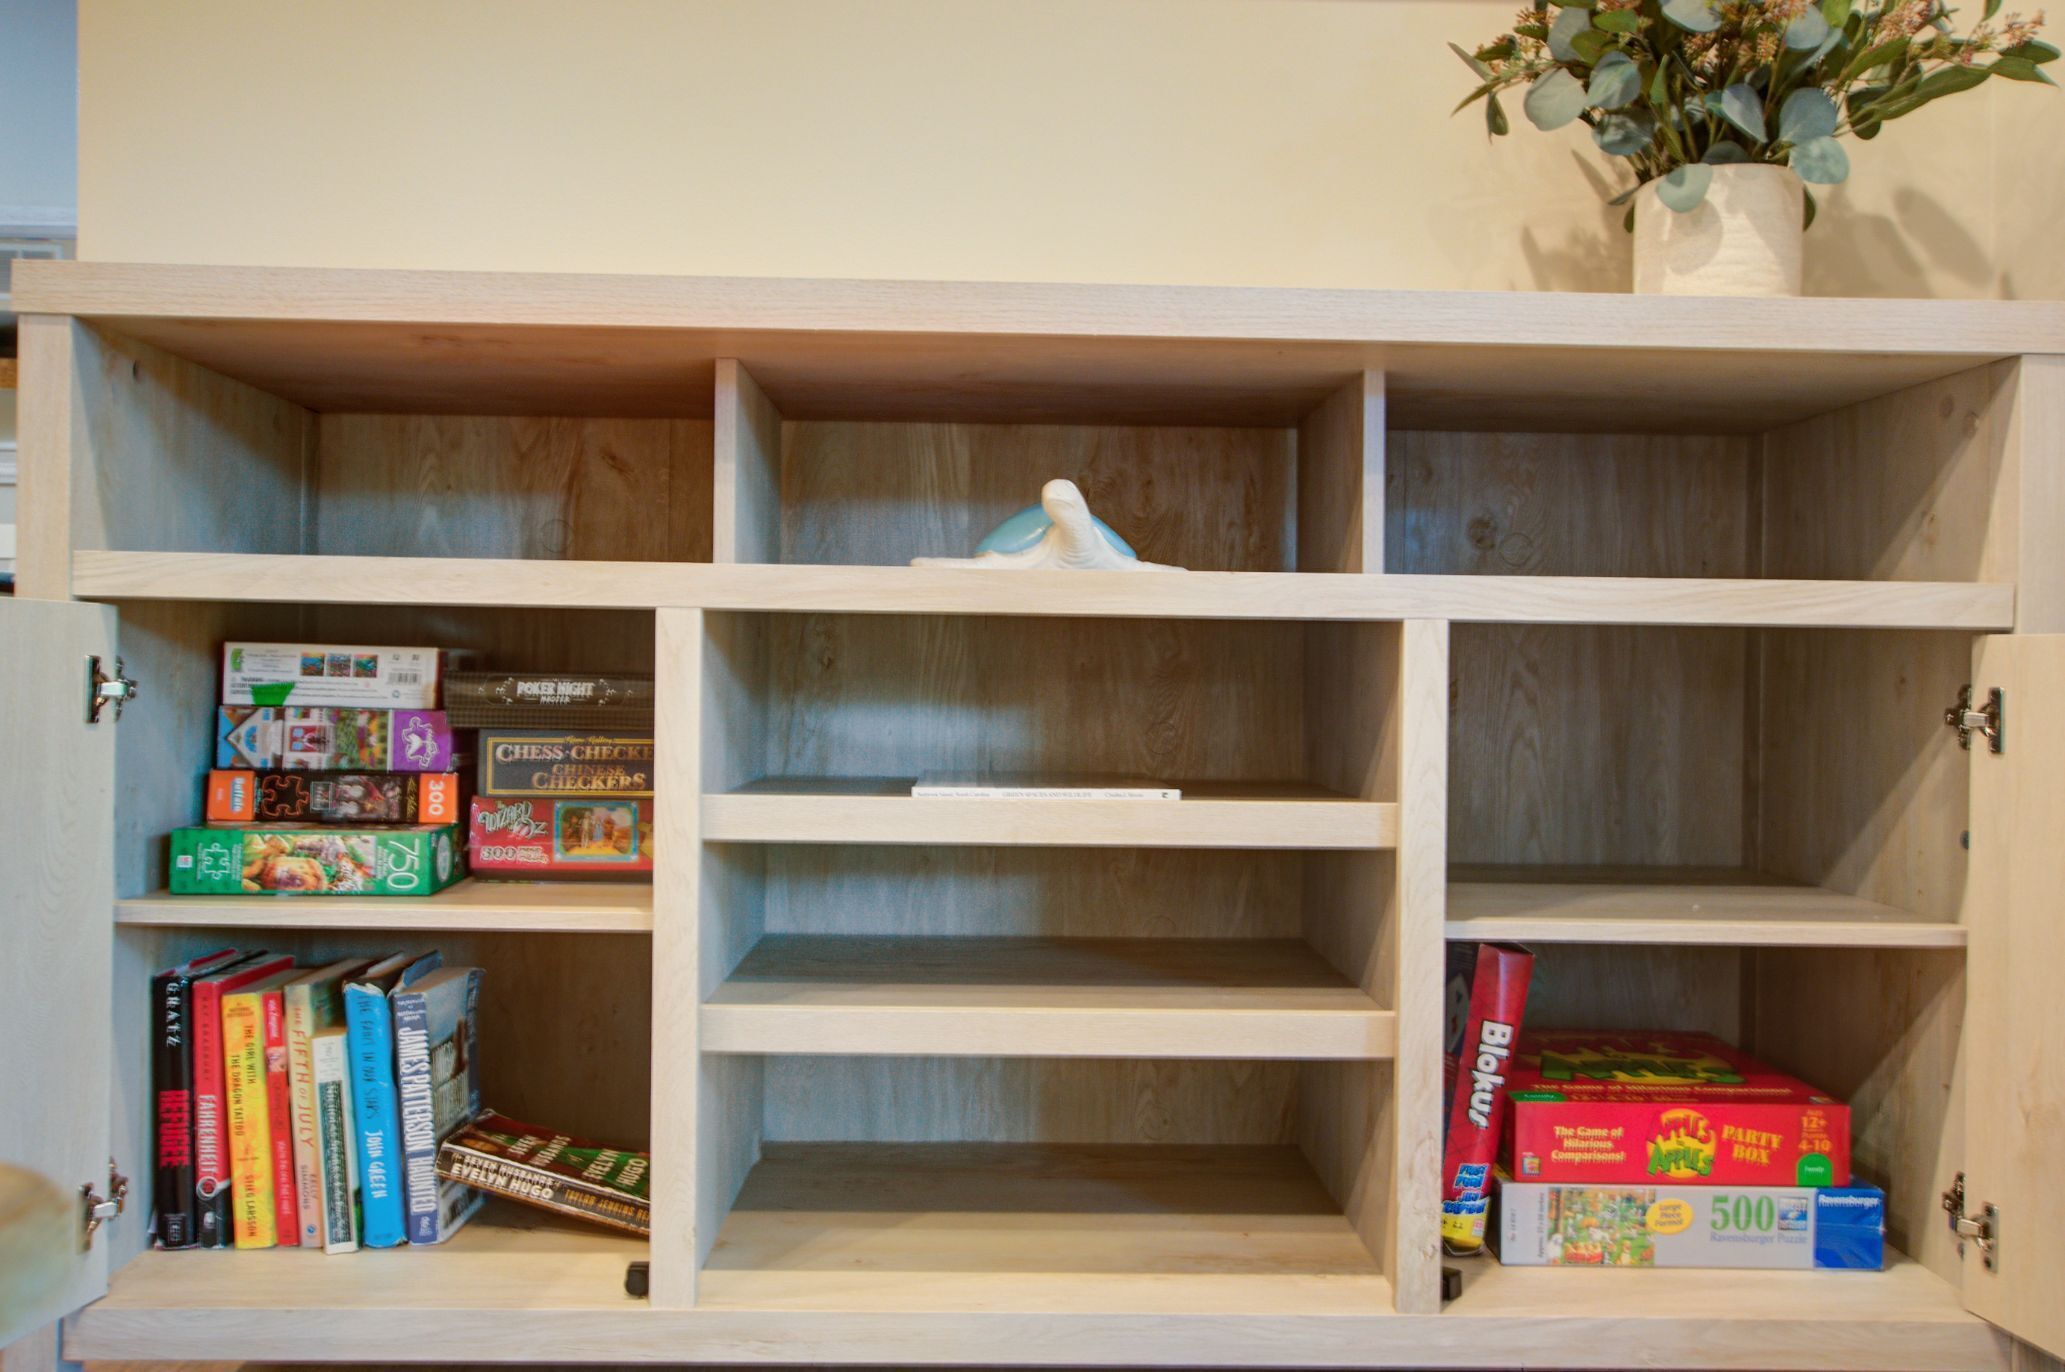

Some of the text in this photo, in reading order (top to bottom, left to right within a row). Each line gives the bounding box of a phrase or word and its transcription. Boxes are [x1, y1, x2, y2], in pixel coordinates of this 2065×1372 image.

[517, 682, 596, 697] POKER NIGHT
[496, 743, 563, 763] CHESS
[531, 772, 645, 790] CHECKERS
[552, 764, 625, 776] CHINESE
[428, 780, 445, 815] 300
[387, 839, 419, 890] 750
[166, 982, 182, 1048] GRATZ
[357, 995, 369, 1014] THE
[243, 1024, 257, 1084] THE GIRL WITH
[364, 1053, 375, 1065] IN
[398, 1027, 429, 1076] JAMES
[291, 1030, 307, 1086] FIFTH
[300, 1103, 315, 1148] JULY
[1468, 1020, 1513, 1129] Blokus
[231, 1055, 244, 1136] THE DRAGON TATTOO
[365, 1087, 378, 1120] STARS
[159, 1089, 190, 1168] REFUGEE
[402, 1076, 434, 1152] PATTERSON
[1801, 1116, 1827, 1128] 12+
[199, 1094, 218, 1173] FAHRENHEIT
[1554, 1126, 1624, 1138] The Game of
[1563, 1138, 1614, 1150] Hilarious
[1721, 1124, 1784, 1149] PARTY
[1799, 1140, 1833, 1152] 4-10
[365, 1130, 388, 1198] JOHN GREEN
[464, 1155, 498, 1171] SEVEN
[499, 1163, 554, 1186] HUSBANDS
[1732, 1144, 1771, 1165] BOX
[408, 1157, 437, 1214] HAUNTED
[451, 1164, 554, 1199] EVELYN HUGO
[616, 1159, 648, 1186] HUGO
[245, 1175, 257, 1237] STIEG LARSSON
[565, 1189, 595, 1205] TAYLOR
[599, 1199, 635, 1216] JENKINS
[1710, 1194, 1775, 1232] 500
[1818, 1194, 1880, 1209] Ravensburger
[1710, 1234, 1807, 1245] Ravensburger Puzzle
